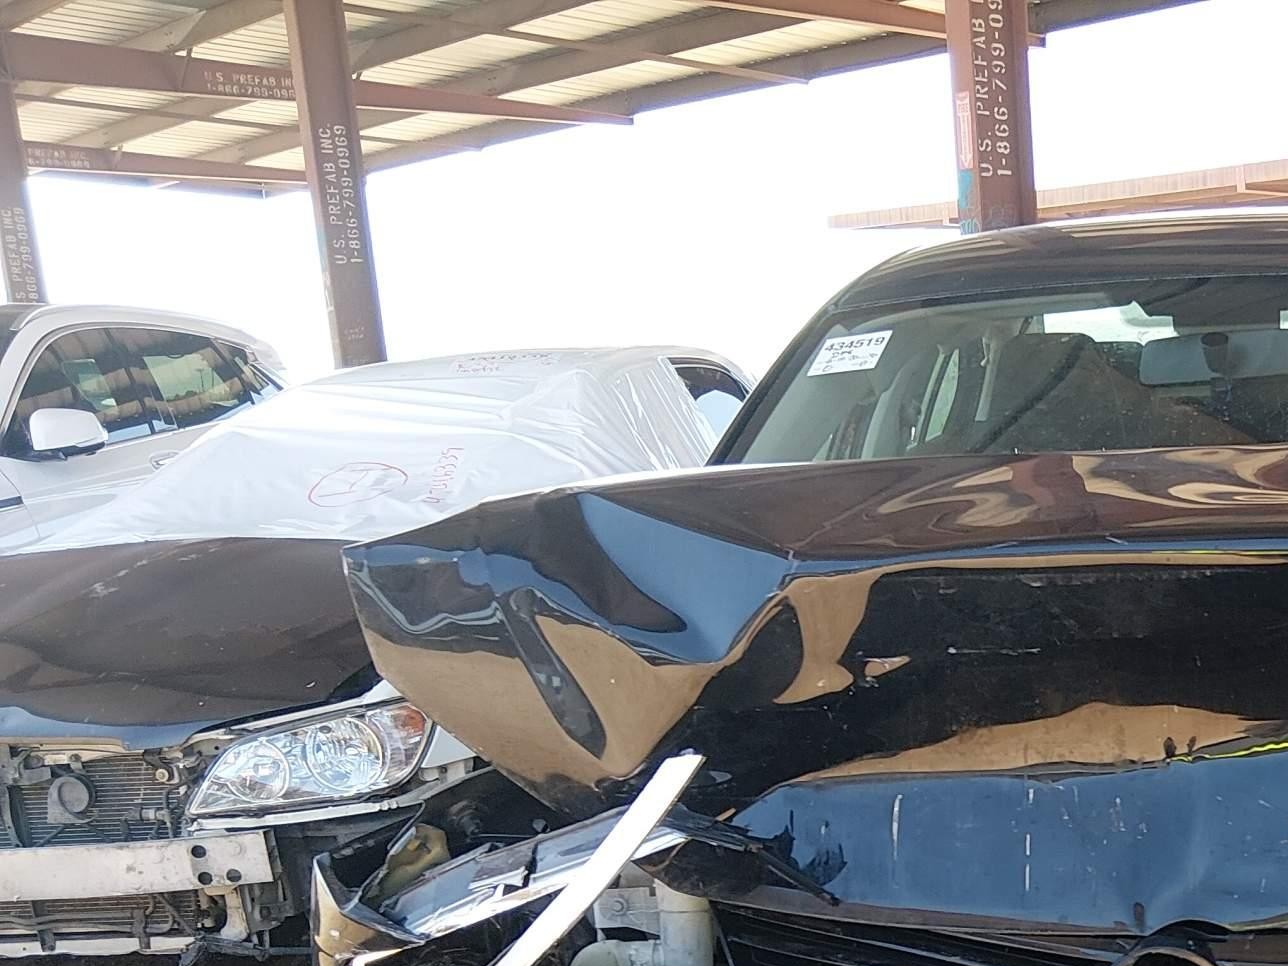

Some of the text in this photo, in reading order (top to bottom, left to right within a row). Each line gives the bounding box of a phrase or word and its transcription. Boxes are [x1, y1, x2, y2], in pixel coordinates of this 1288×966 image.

[207, 83, 296, 98] 1-866-799-096
[280, 77, 294, 88] IN
[972, 18, 990, 115] PREFAB
[988, 0, 1012, 176] 1-866-799-09
[319, 123, 348, 264] U.S. PREFAB INC.
[333, 125, 364, 263] 1-866-799-0969
[978, 131, 994, 178] U.S.
[12, 207, 39, 303] -866-799-0969
[825, 336, 886, 352] 434519
